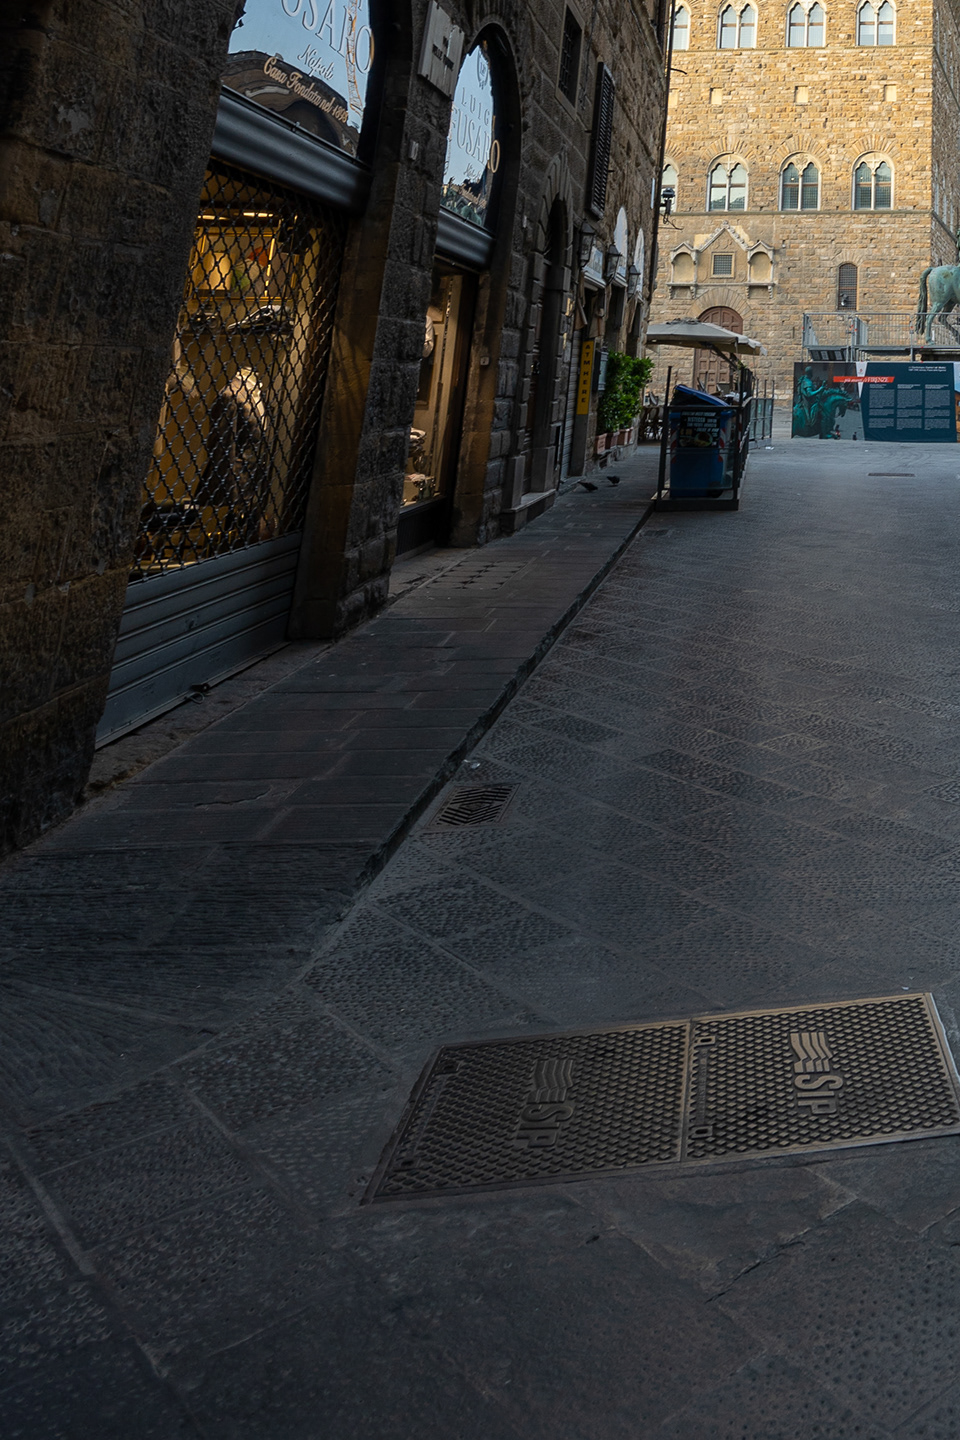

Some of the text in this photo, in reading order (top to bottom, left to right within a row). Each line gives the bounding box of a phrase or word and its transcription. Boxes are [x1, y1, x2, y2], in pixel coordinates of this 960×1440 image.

[296, 43, 335, 81] Napoli
[263, 56, 288, 84] Casa
[286, 71, 322, 106] Fondata
[319, 96, 336, 113] nel
[581, 344, 591, 404] ATM HERE
[795, 1074, 844, 1115] SIP
[516, 1104, 574, 1148] SIP
